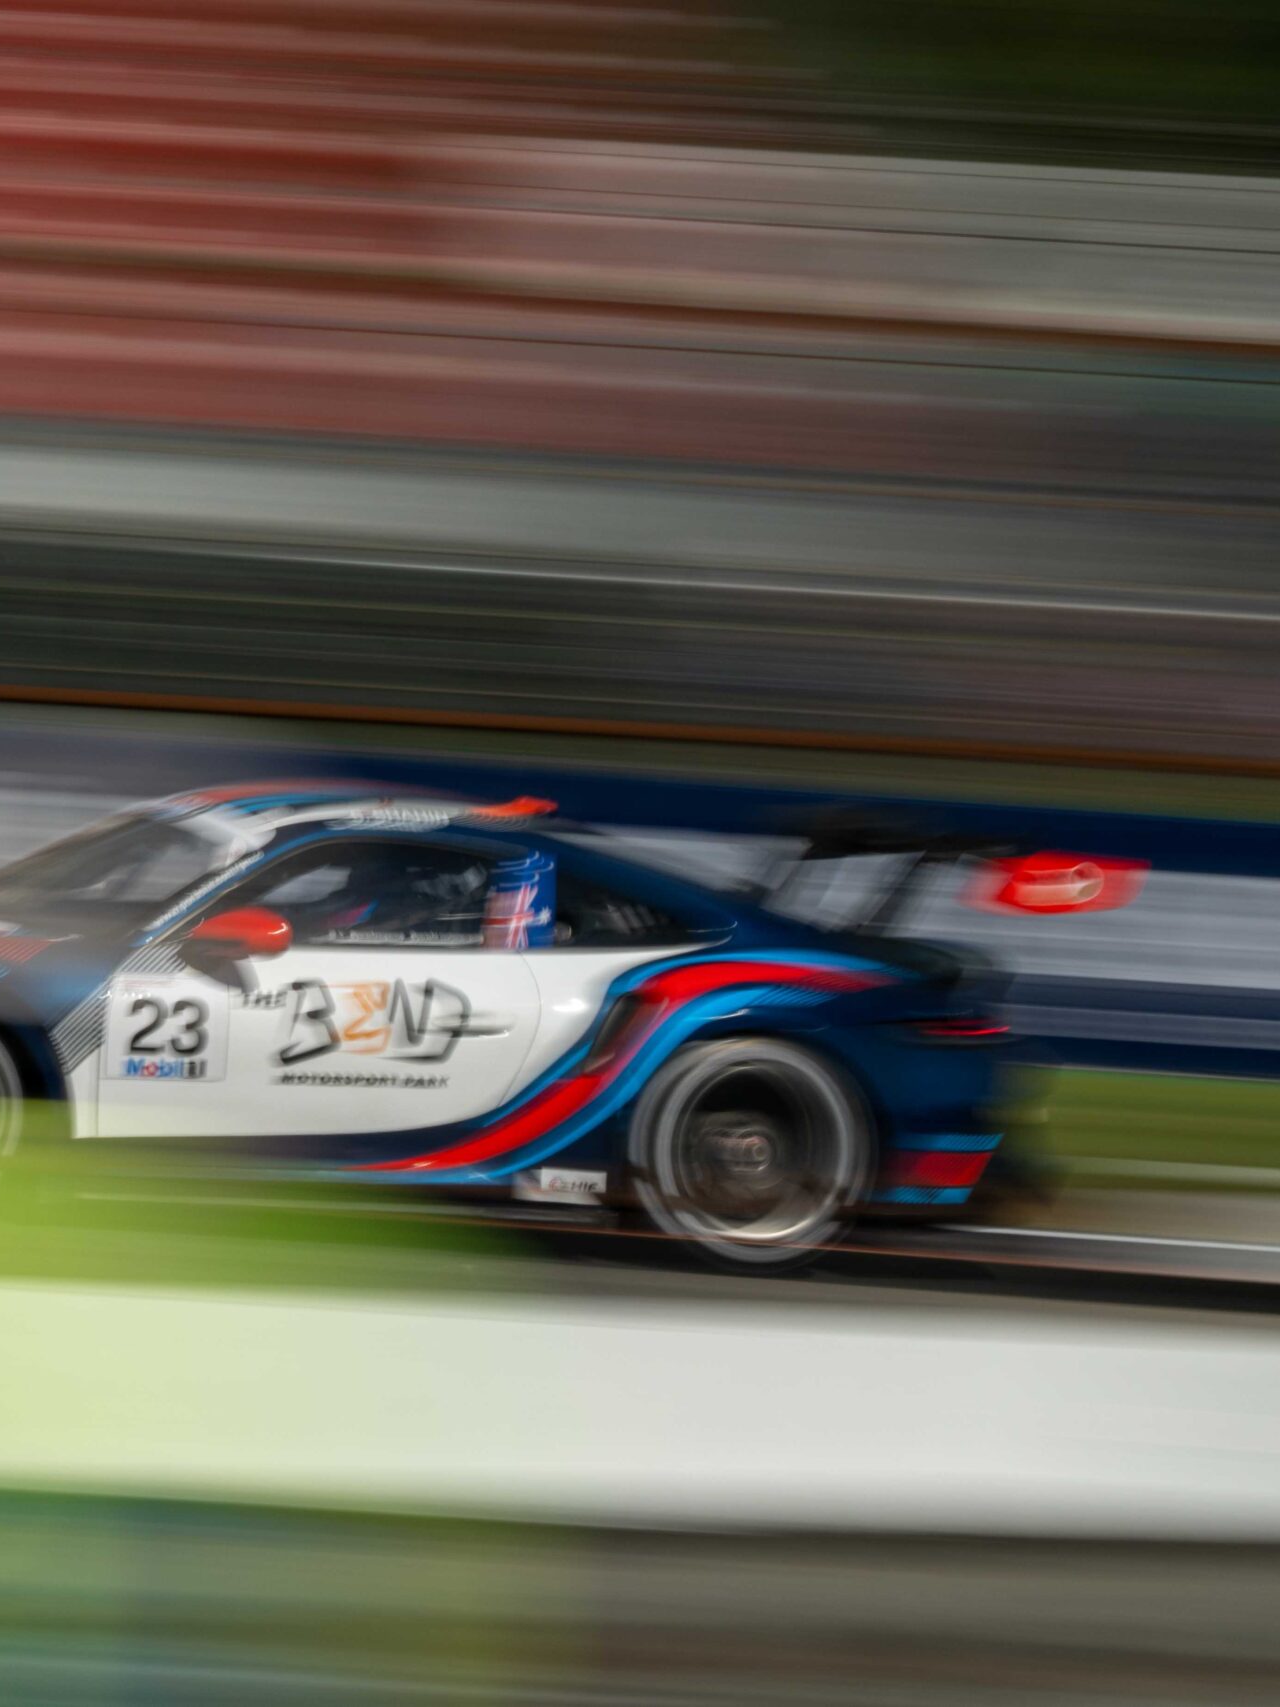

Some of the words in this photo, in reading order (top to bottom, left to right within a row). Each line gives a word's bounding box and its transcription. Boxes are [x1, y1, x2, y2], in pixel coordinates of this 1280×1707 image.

[242, 990, 287, 1010] THE
[127, 998, 209, 1057] 23
[125, 1057, 185, 1078] Mobil
[279, 1072, 398, 1087] MOTORSPORT
[404, 1075, 449, 1089] PARK
